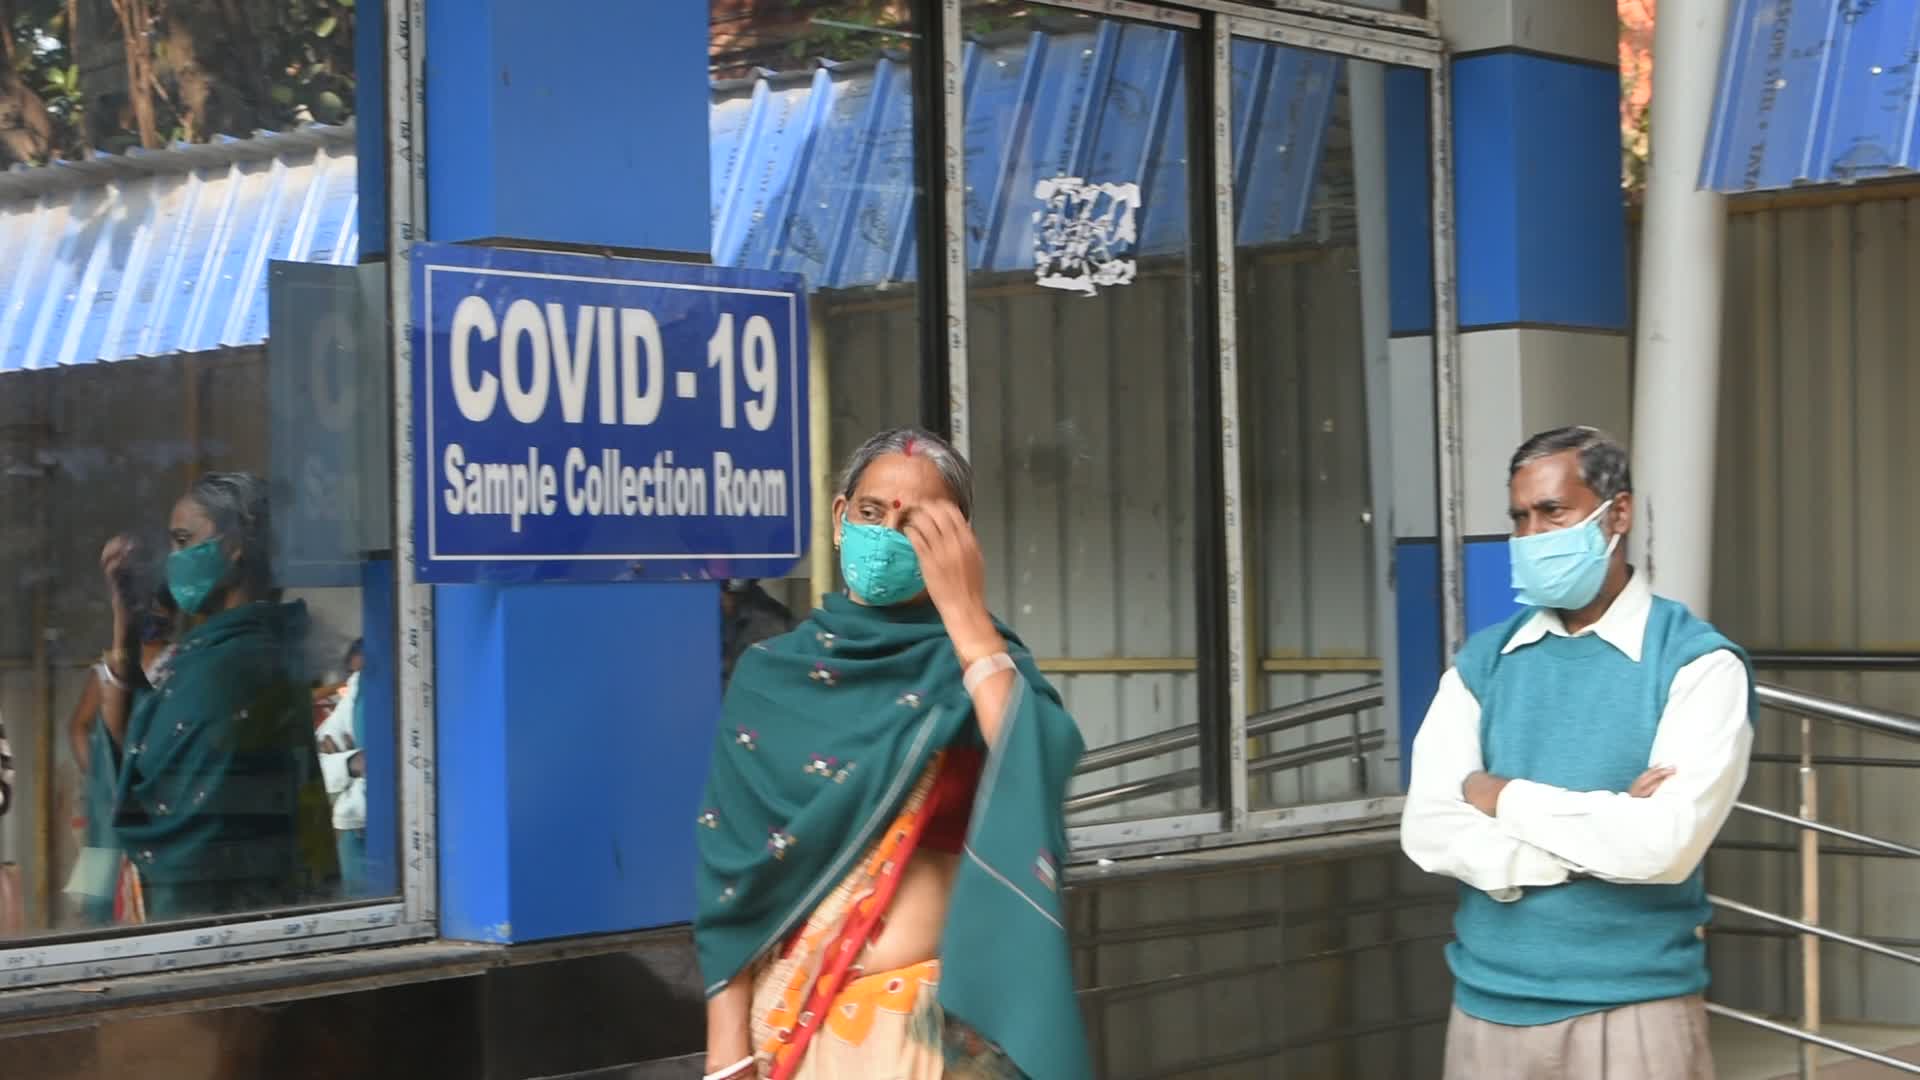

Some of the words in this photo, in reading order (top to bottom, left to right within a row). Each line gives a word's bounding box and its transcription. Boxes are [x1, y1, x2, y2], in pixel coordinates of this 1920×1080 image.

[450, 295, 664, 425] COVID
[707, 312, 778, 431] 19
[444, 443, 558, 532] Sample
[564, 446, 707, 516] Collection
[713, 451, 787, 516] Room
